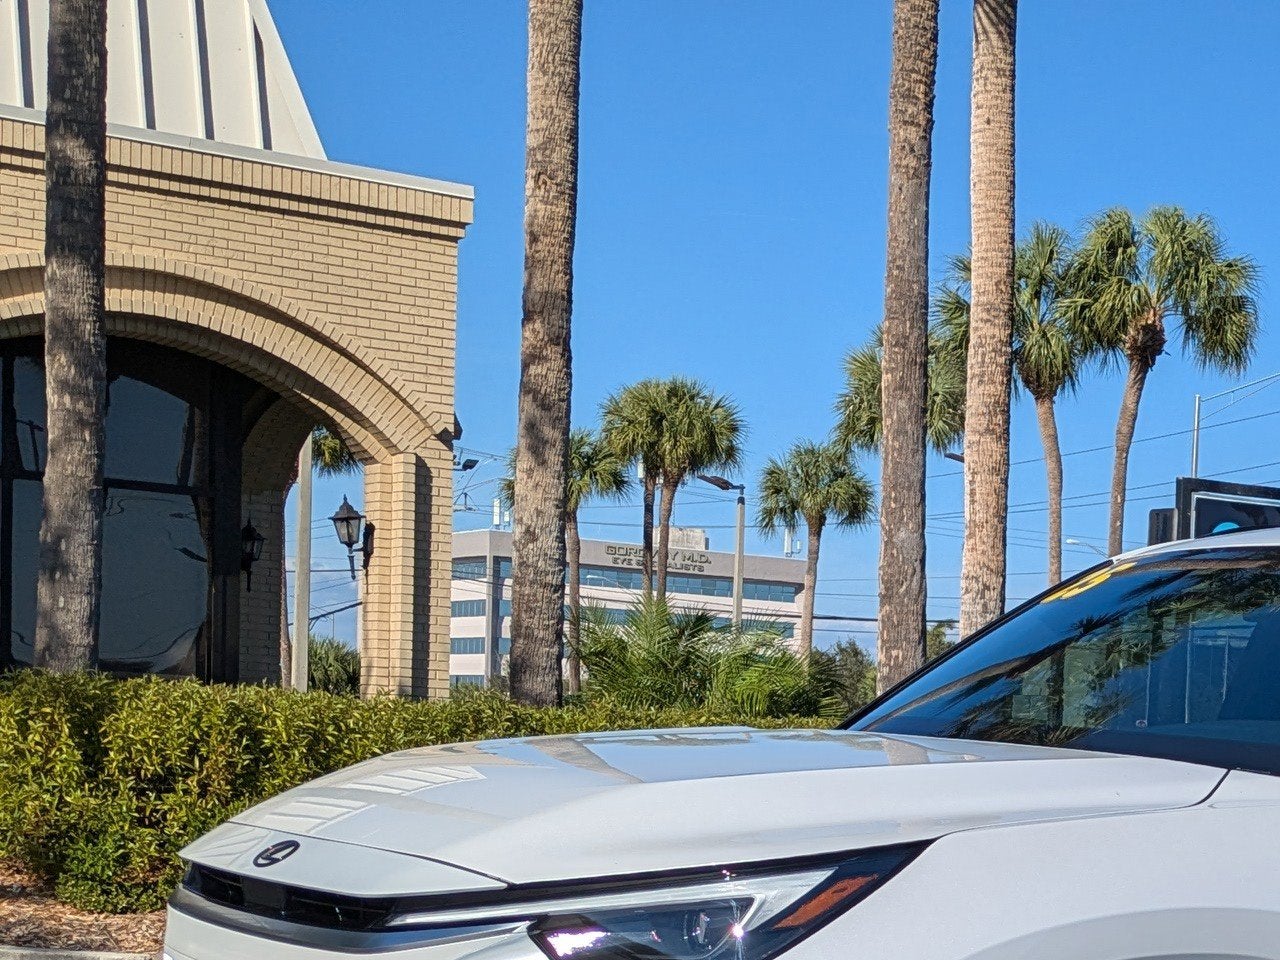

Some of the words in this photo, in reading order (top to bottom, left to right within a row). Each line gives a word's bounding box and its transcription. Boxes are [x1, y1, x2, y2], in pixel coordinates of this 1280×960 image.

[612, 556, 633, 566] EYE
[636, 560, 705, 573] SEALISTS
[682, 553, 712, 565] M.D.
